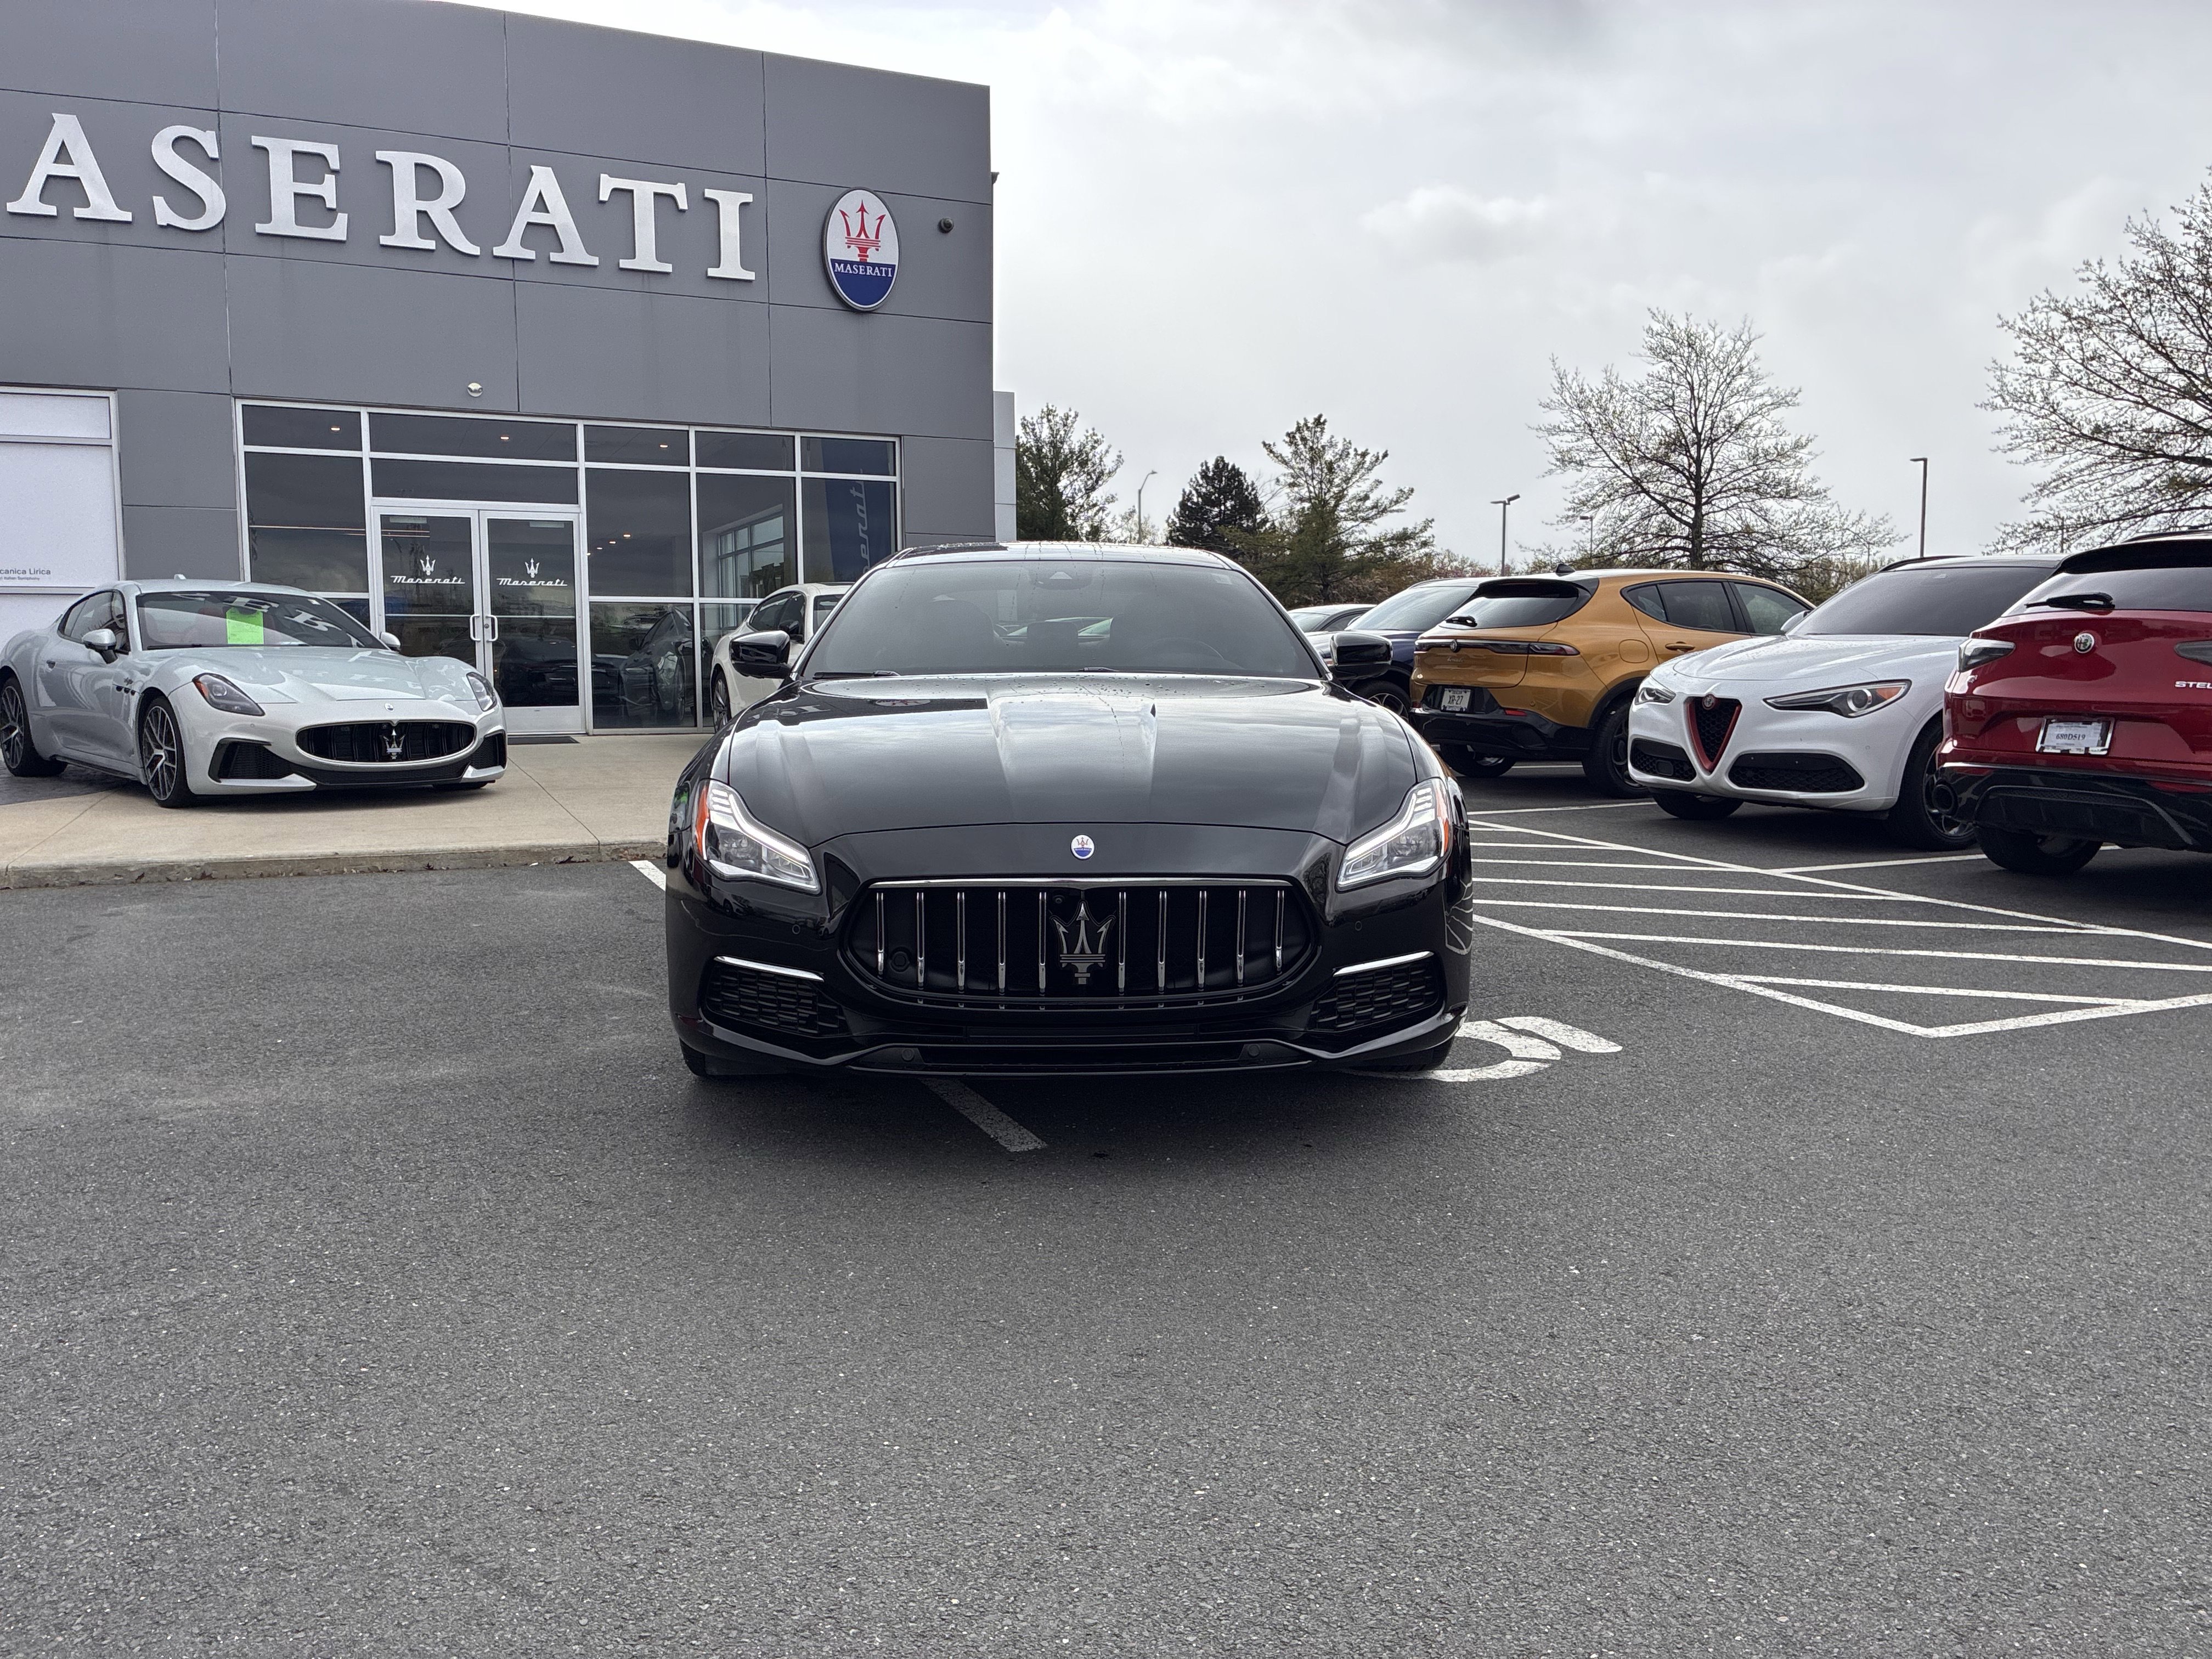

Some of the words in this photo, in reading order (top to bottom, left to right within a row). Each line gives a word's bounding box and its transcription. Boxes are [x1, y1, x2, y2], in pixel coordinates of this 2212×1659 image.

[834, 263, 893, 277] MASERATI
[390, 575, 466, 584] Maserati
[496, 578, 568, 586] Maserati
